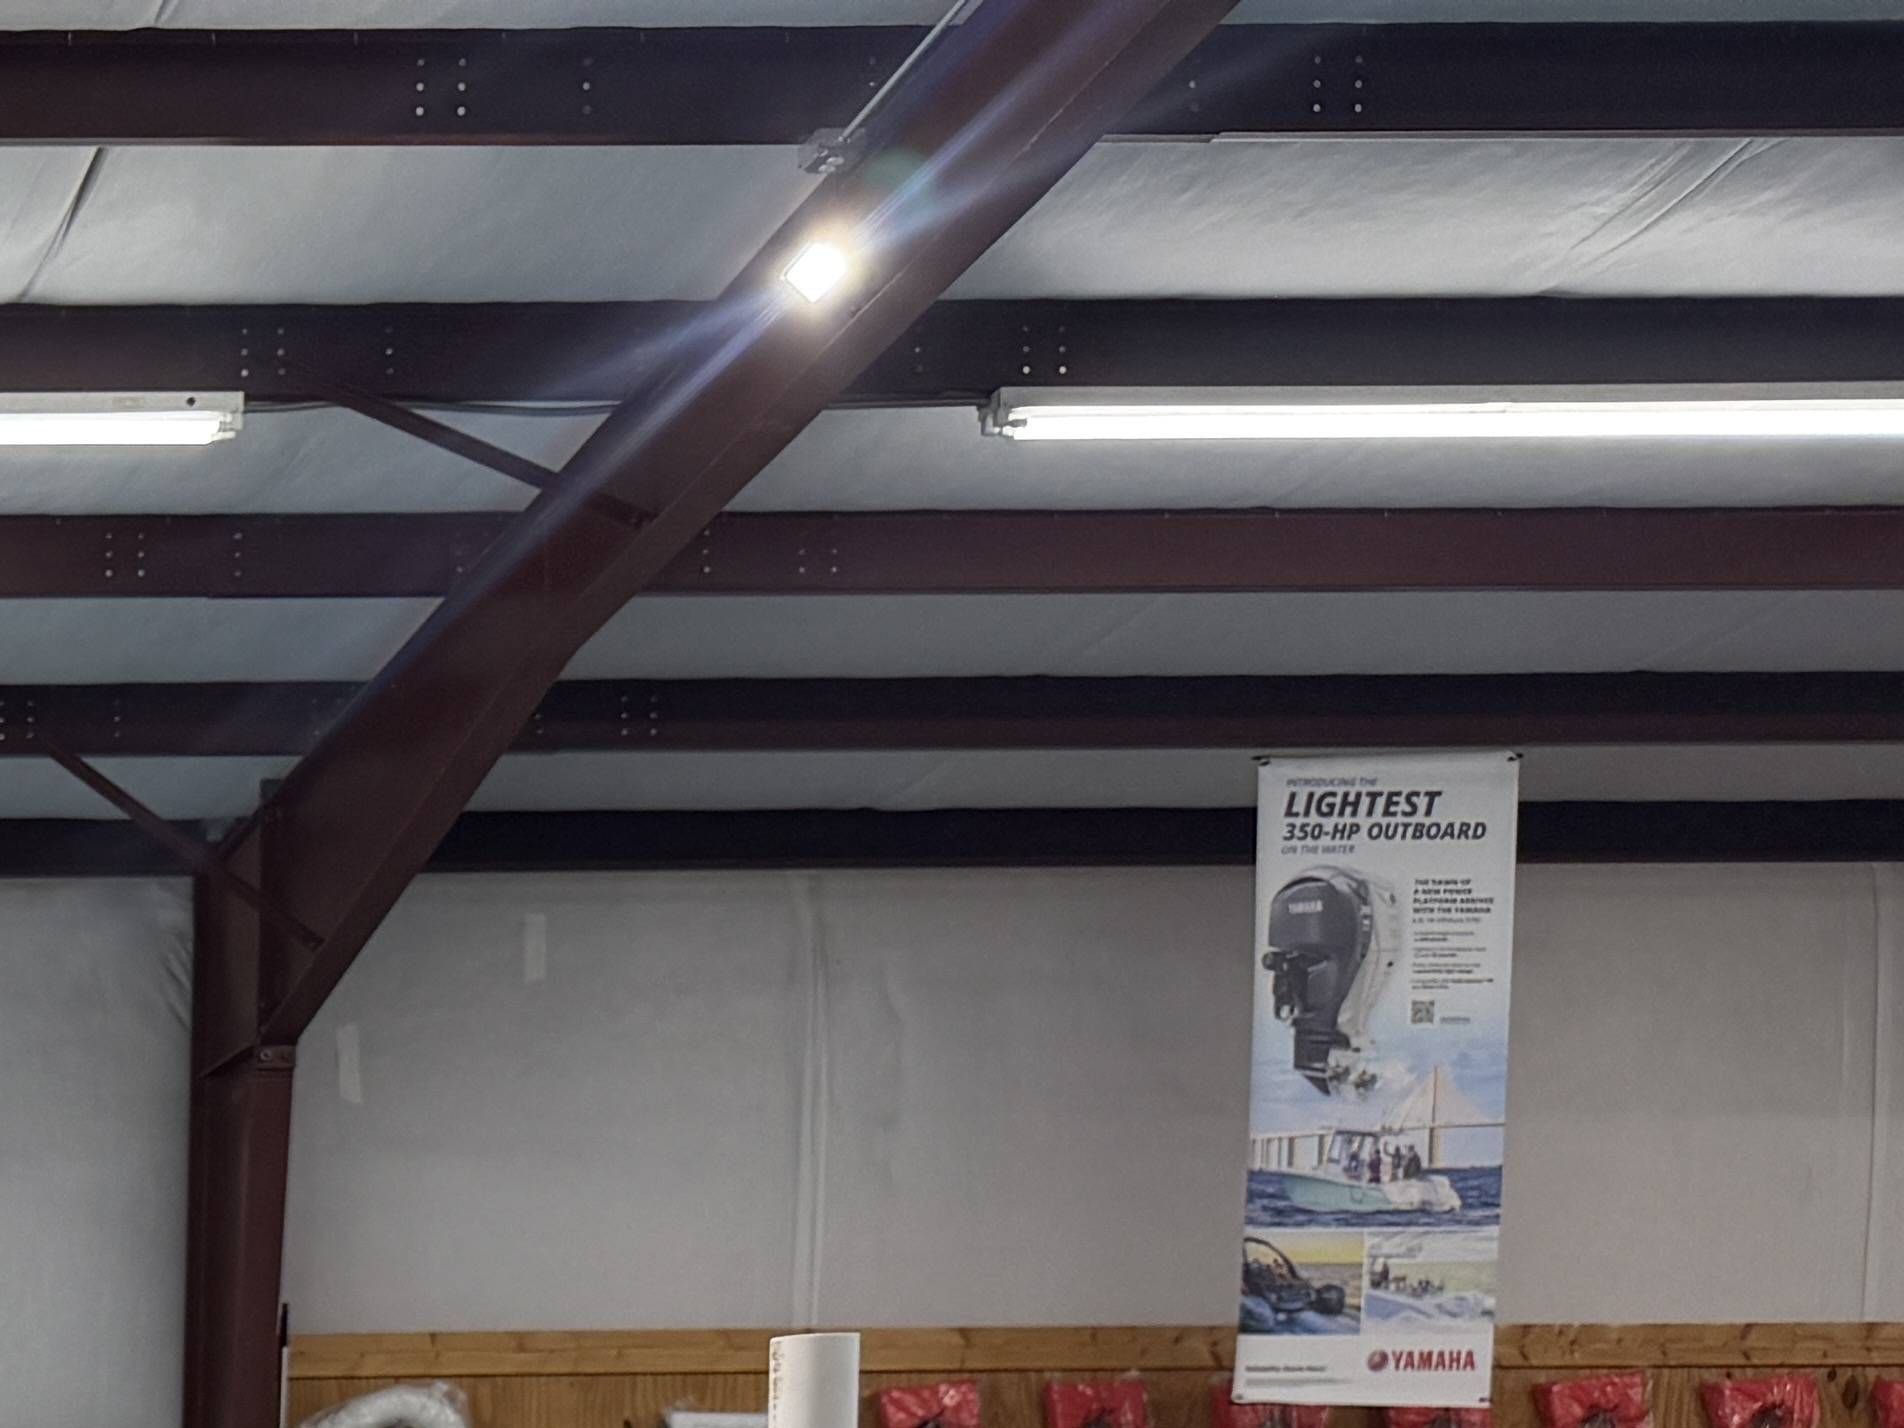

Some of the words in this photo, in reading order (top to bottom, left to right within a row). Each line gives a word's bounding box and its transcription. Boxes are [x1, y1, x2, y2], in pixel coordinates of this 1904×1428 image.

[1359, 777, 1378, 787] THE
[1283, 790, 1443, 818] LIGHTEST
[1283, 822, 1361, 841] 350-HP
[1367, 821, 1487, 841] OUTBOARD
[1392, 1350, 1476, 1371] YAMAHA
